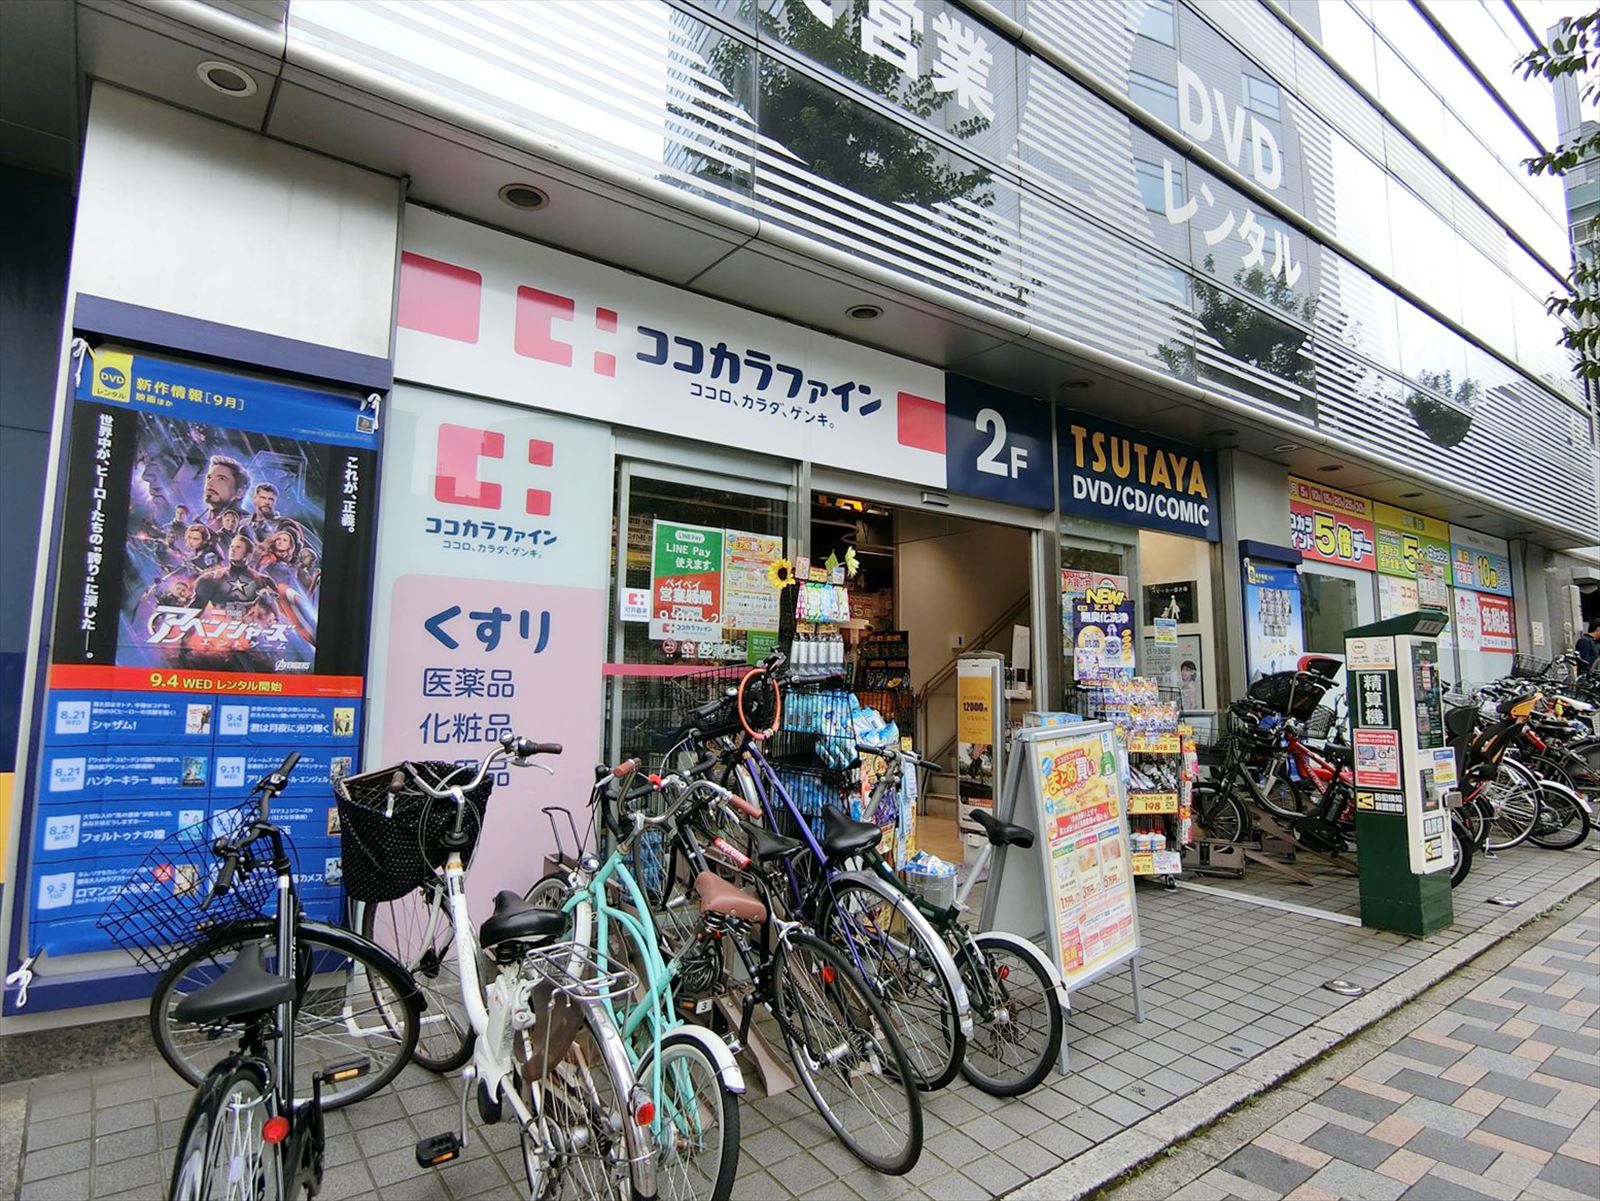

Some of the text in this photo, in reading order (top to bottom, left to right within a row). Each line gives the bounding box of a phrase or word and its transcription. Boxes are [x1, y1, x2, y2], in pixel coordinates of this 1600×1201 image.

[805, 0, 995, 122] 営業
[1177, 60, 1282, 190] DVD
[1163, 158, 1302, 288] レンタル
[100, 373, 125, 385] DVD
[635, 325, 882, 417] ココカラファイン
[96, 387, 126, 400] レンタル
[690, 383, 836, 430] ココロ、カラダ、ゲンキ。
[975, 408, 1028, 479] 2F
[1070, 424, 1208, 499] TSUTAYA
[1072, 474, 1210, 527] DVD/CD/COMIC
[425, 516, 558, 547] ココカラファイン
[442, 540, 543, 559] ココロ、カラダ、ゲンキ。
[665, 543, 712, 558] LINE Pay
[675, 557, 715, 571] 使えます。
[147, 605, 297, 643] アベンジャーズ
[425, 605, 551, 654] くすり
[149, 673, 284, 694] 9.4 WED レンタル開始
[422, 667, 515, 698] 医薬品
[1363, 674, 1385, 725] 精算機
[60, 710, 86, 720] 8.21
[91, 720, 138, 730] シャザム!
[226, 713, 243, 723] 9.4
[250, 723, 330, 734] 君は月夜に光り輝く
[419, 712, 513, 745] 化粧品
[55, 767, 81, 777] 8.21
[86, 775, 149, 786] ハンターキラー
[220, 765, 241, 775] 9.11
[1145, 801, 1161, 811] 198
[49, 824, 75, 836] 8.21
